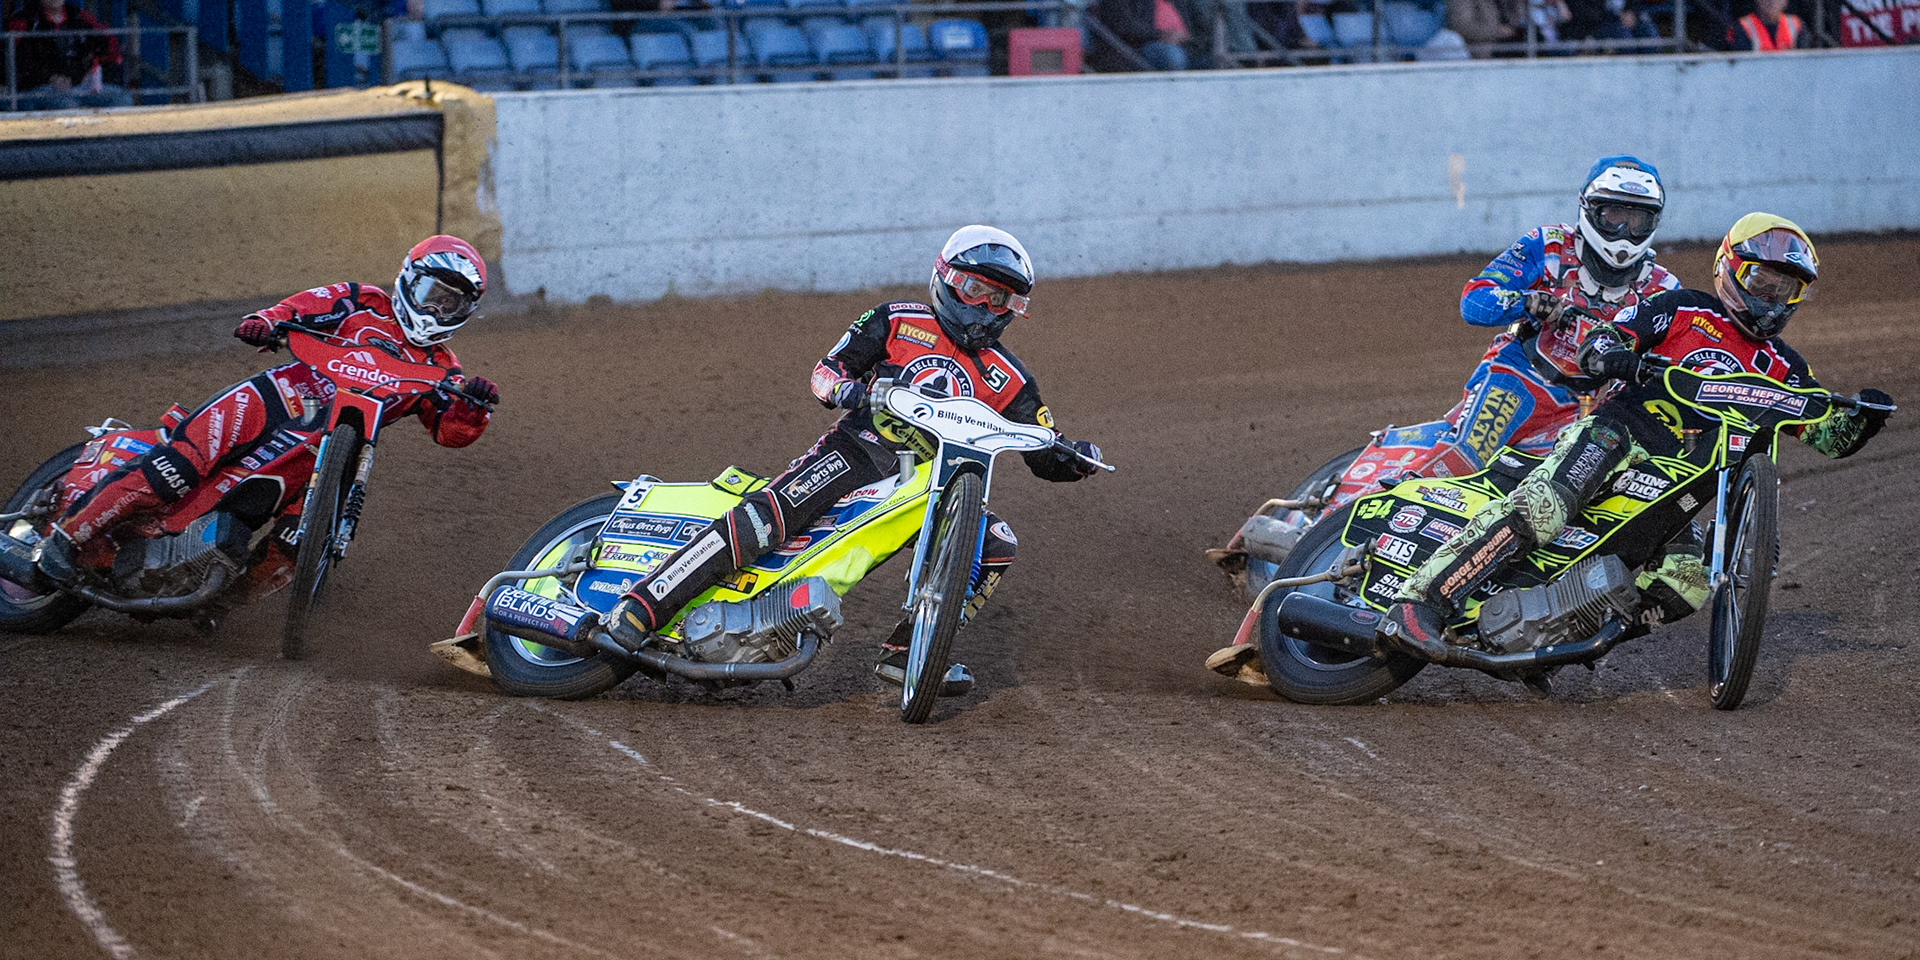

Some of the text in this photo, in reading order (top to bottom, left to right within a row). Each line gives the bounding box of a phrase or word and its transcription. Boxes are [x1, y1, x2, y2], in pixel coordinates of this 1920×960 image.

[898, 323, 939, 344] HYCOTE
[1692, 315, 1723, 340] HYCOTE
[909, 358, 939, 375] BELLE
[942, 360, 960, 376] VUE
[1692, 352, 1739, 371] ELLE VUE
[327, 359, 400, 388] Crendon
[339, 372, 360, 383] TIMBER
[989, 371, 1002, 389] 5
[1702, 384, 1749, 396] GEORGE
[1736, 395, 1757, 403] SON
[1758, 398, 1777, 406] LTD
[228, 401, 249, 448] burnside
[937, 409, 962, 425] Billig
[1466, 386, 1506, 450] KEVIN
[1477, 391, 1520, 466] MOORE
[1565, 442, 1599, 481] ANDERSON
[152, 455, 185, 489] LUCAS
[789, 479, 811, 499] Claus
[811, 466, 828, 484] Ørts
[826, 459, 844, 474] Byg
[1635, 470, 1670, 489] KING
[628, 488, 647, 504] 5
[1627, 481, 1662, 499] DICK
[1357, 499, 1396, 520] #34
[1393, 512, 1421, 525] STS
[611, 519, 636, 532] Claus
[635, 521, 656, 533] Ørts
[1429, 520, 1460, 537] GEORG
[1386, 538, 1416, 558] FTS
[1471, 525, 1512, 566] HEPBURN
[666, 540, 717, 582] Billig Ventilation
[1466, 564, 1485, 580] SON
[1483, 550, 1498, 566] LTD
[498, 594, 557, 621] BLINDS
[513, 614, 539, 627] PERFECT
[540, 621, 550, 629] FIT
